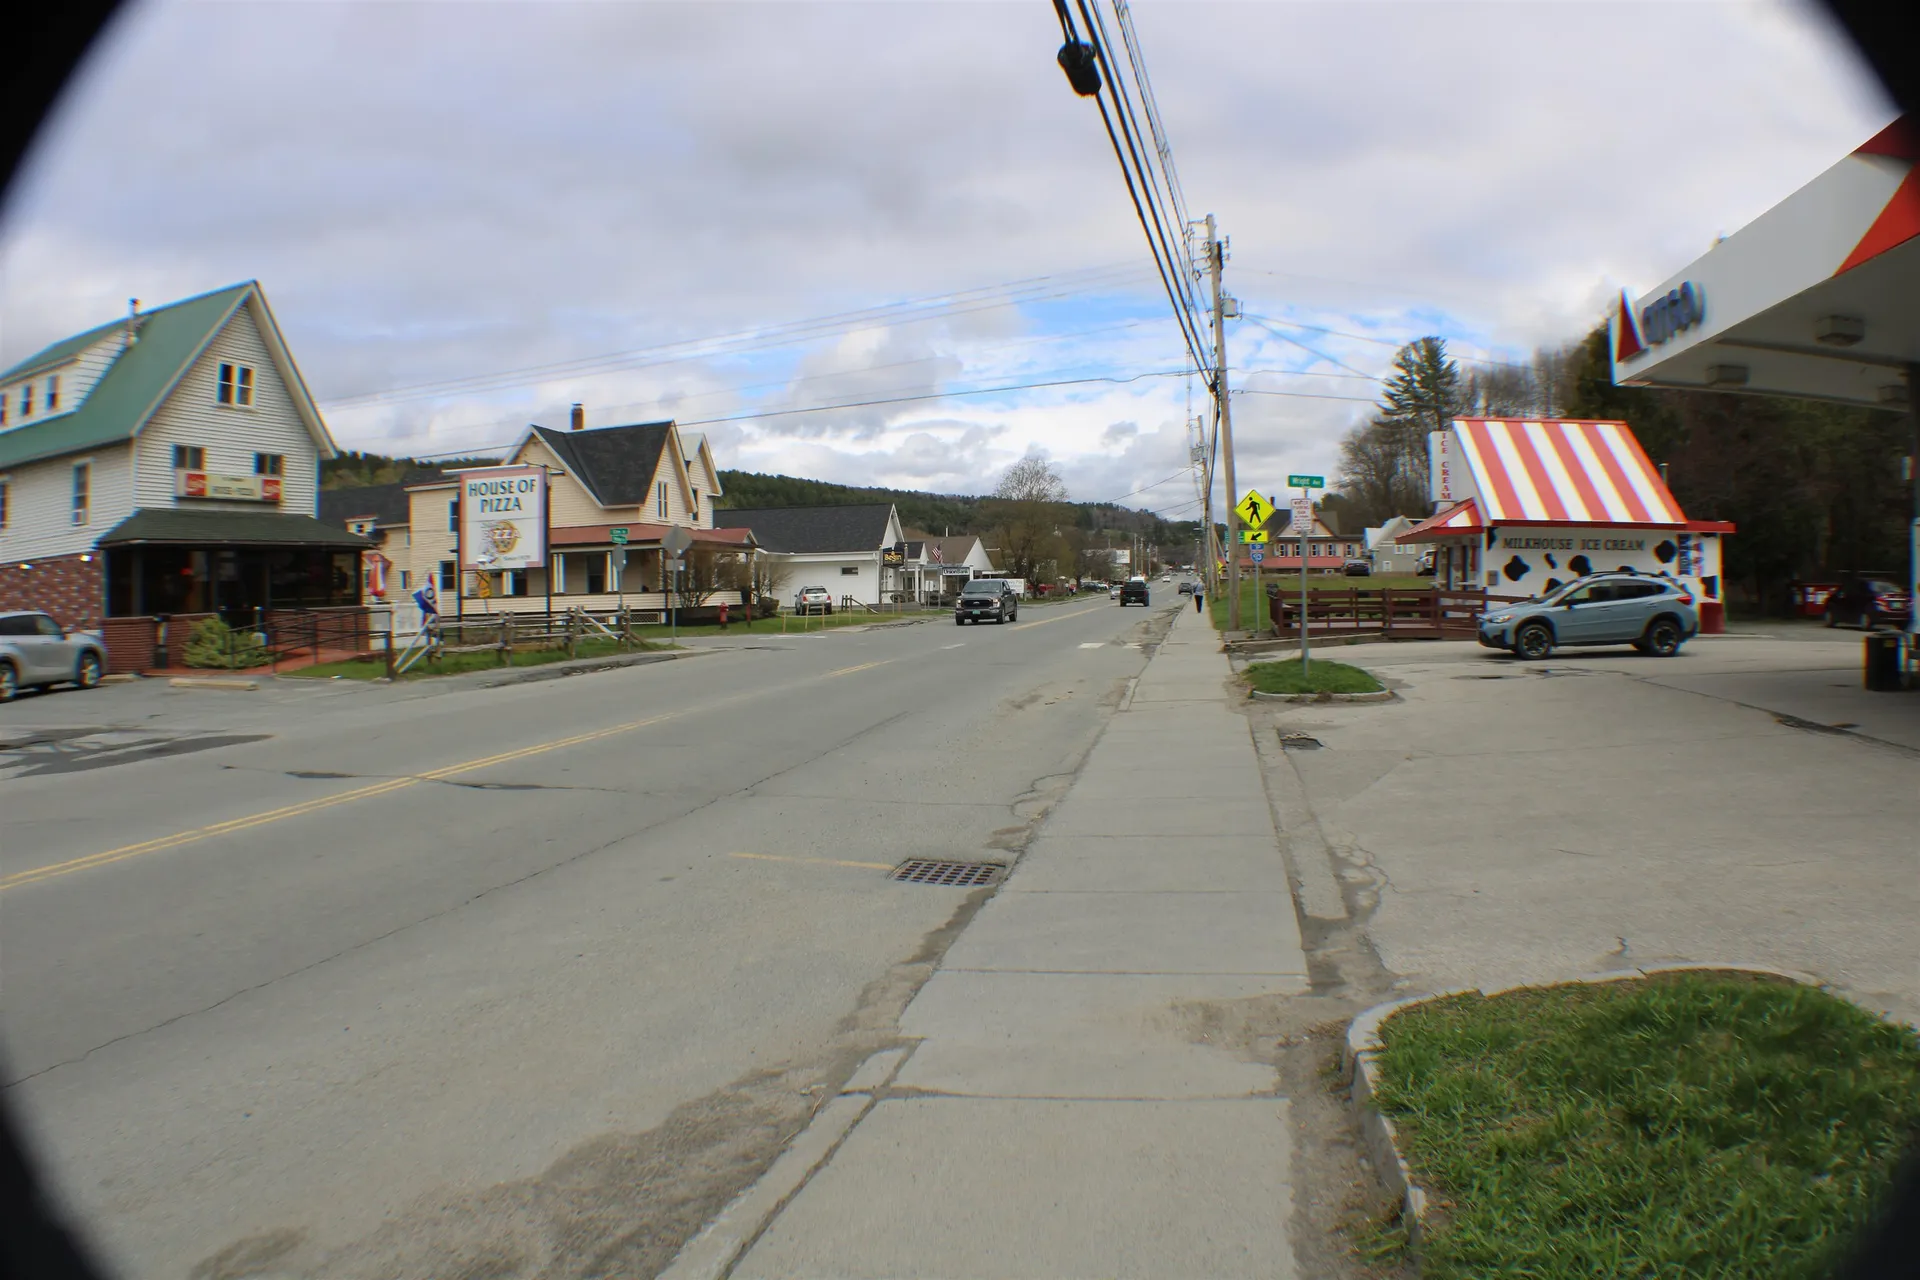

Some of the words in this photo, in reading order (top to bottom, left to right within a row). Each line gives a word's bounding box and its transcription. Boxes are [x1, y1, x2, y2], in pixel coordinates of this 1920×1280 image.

[1441, 432, 1449, 454] ICE
[468, 480, 515, 497] HOUSE
[516, 479, 537, 493] OF
[1441, 461, 1452, 500] CREAM
[480, 497, 522, 513] PIZZA
[1503, 538, 1573, 550] MILKHOUSE
[1580, 539, 1601, 551] ICE
[1604, 539, 1646, 551] CREAM
